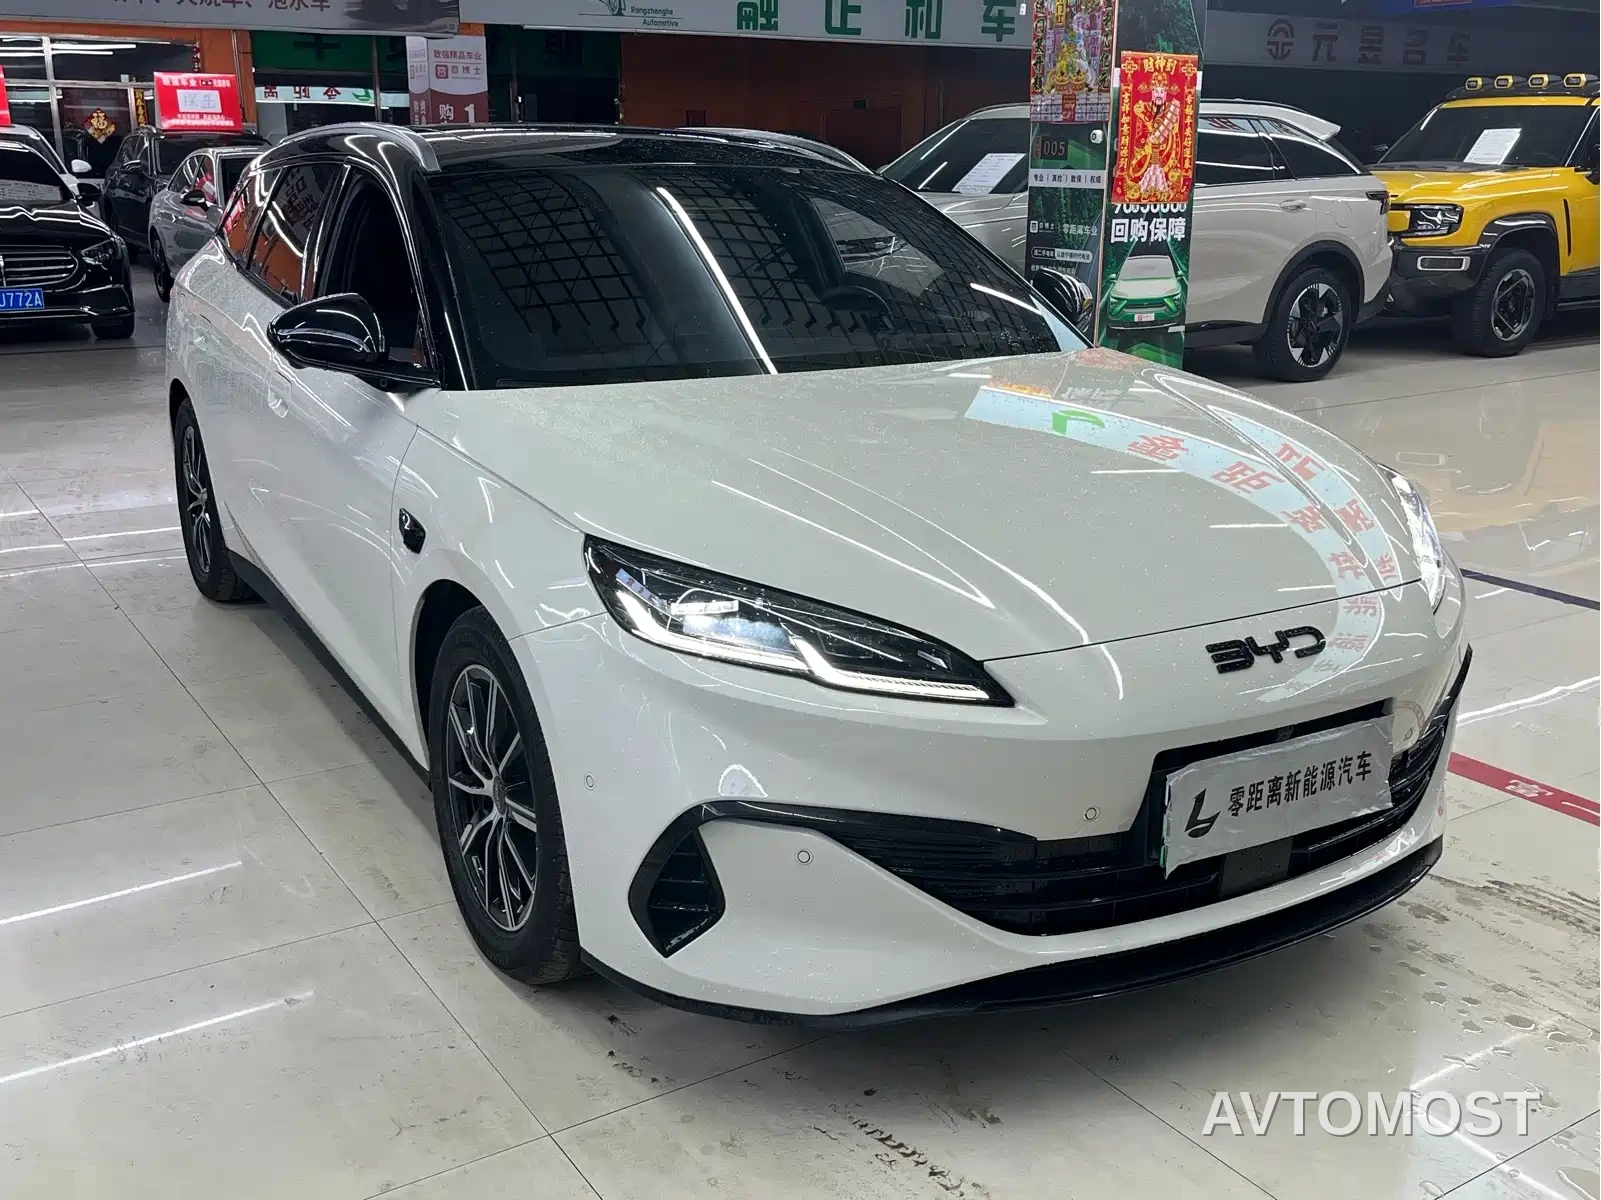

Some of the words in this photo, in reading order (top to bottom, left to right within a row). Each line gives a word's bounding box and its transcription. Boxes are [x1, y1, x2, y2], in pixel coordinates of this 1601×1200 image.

[642, 18, 679, 28] Automotive
[1043, 140, 1066, 156] 005
[1110, 217, 1186, 243] 回购保障
[1205, 625, 1326, 674] BYD
[1227, 751, 1372, 818] 零距离新能源汽车
